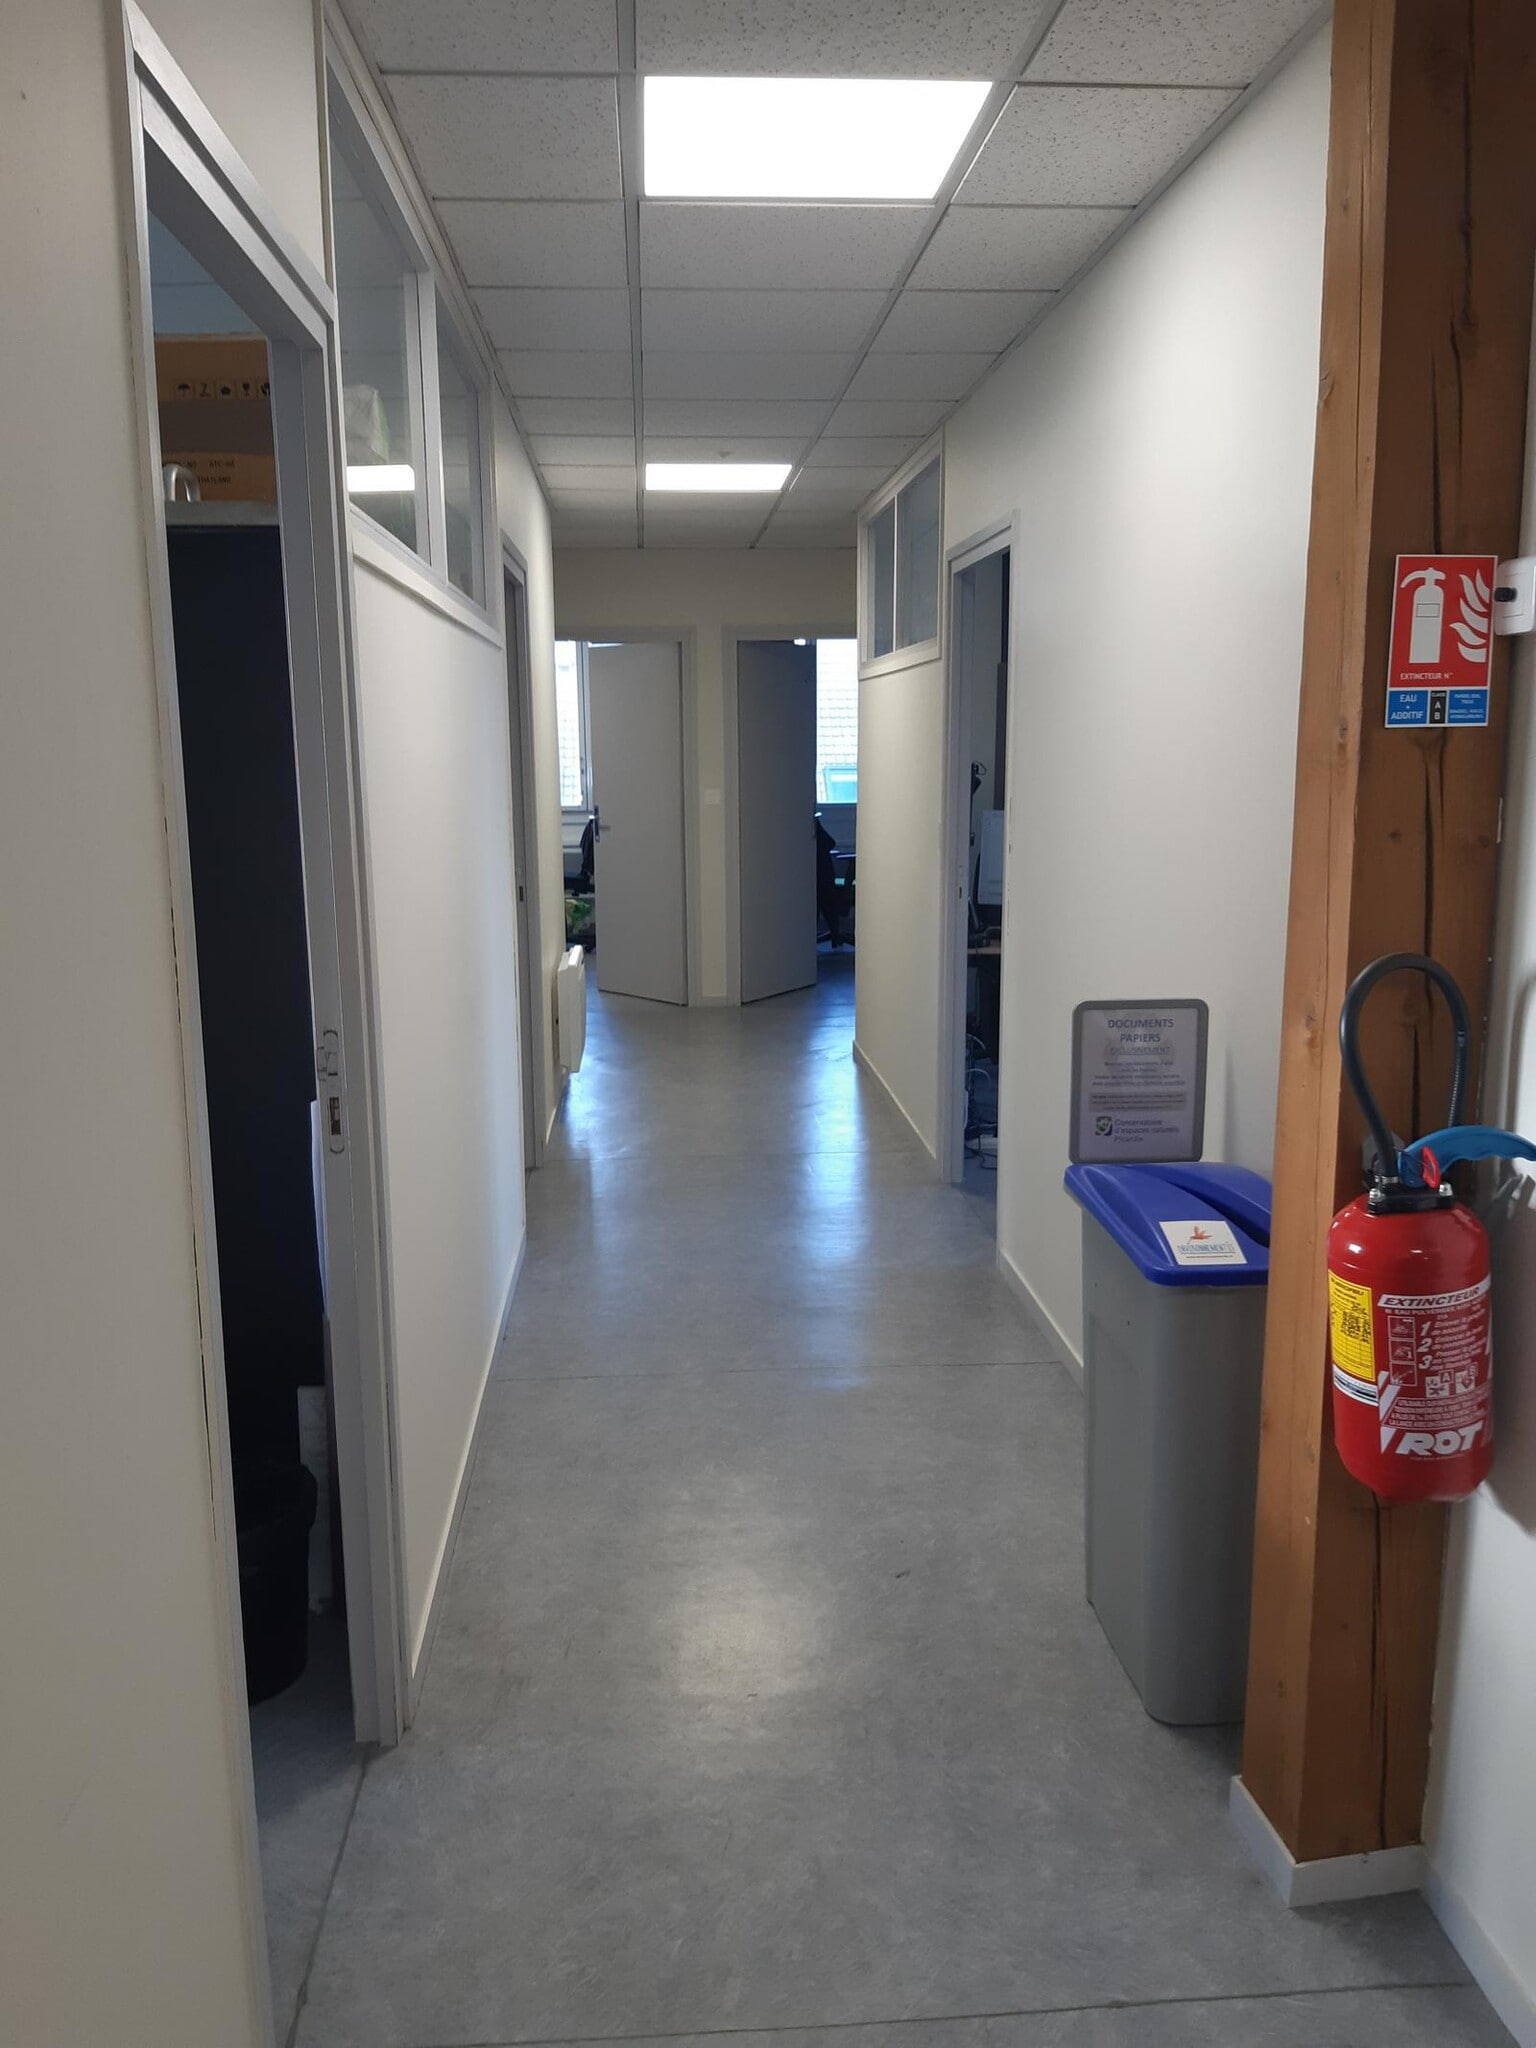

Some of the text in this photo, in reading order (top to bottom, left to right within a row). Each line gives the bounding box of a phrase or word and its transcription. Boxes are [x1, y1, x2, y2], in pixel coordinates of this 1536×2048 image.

[1400, 672, 1442, 680] EXTINCTEUR
[1399, 694, 1418, 703] EAU
[1434, 700, 1441, 709] A
[1390, 711, 1424, 720] ADDITIF
[1434, 712, 1441, 720] B
[1107, 1019, 1175, 1029] DOCUMENTS
[1120, 1033, 1161, 1043] PAPIERS
[1384, 1286, 1480, 1307] EXTINCTEUR
[1420, 1321, 1432, 1337] 1
[1417, 1338, 1433, 1353] 2
[1418, 1355, 1433, 1370] 3
[1441, 1372, 1452, 1383] A
[1395, 1420, 1484, 1456] ROT
